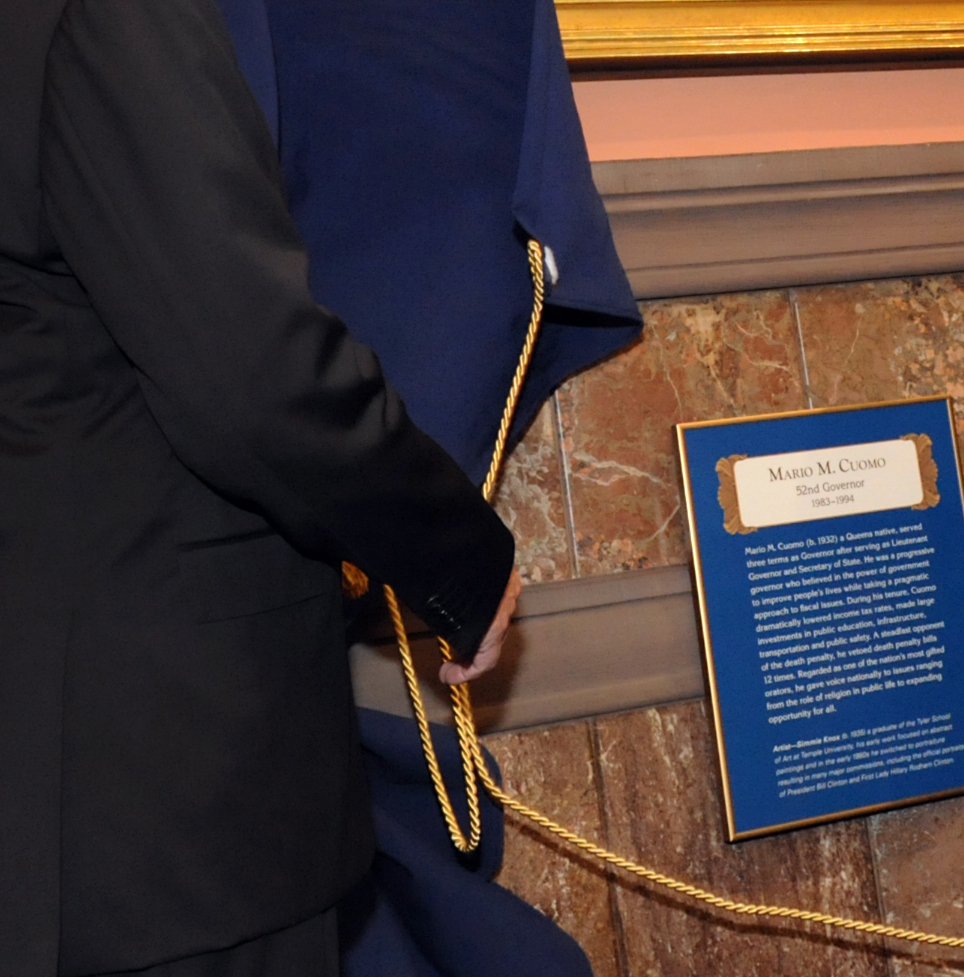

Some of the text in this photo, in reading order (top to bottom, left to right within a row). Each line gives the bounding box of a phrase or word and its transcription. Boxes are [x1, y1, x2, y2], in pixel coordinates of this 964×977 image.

[817, 461, 836, 476] M.
[796, 480, 865, 495] 52nd Governor
[745, 546, 767, 555] Mario
[767, 544, 777, 552] M.
[777, 541, 805, 550] Cuomo
[806, 538, 816, 548] (b.
[817, 535, 838, 545] 1932)
[845, 531, 873, 541] Queens
[899, 523, 923, 533] served
[746, 559, 766, 568] three
[767, 556, 789, 565] terms
[800, 550, 834, 560] Governor
[836, 546, 853, 555] after
[854, 543, 881, 552] serving
[891, 535, 928, 547] Lieutenant
[748, 570, 782, 581] Governor
[783, 566, 798, 576] and
[798, 563, 832, 573] Secretary
[833, 559, 841, 568] of
[842, 558, 862, 567] State.
[864, 555, 874, 563] He
[896, 547, 935, 560] progressive
[750, 583, 783, 596] governor
[785, 580, 801, 588] who
[801, 574, 833, 586] believed
[855, 569, 877, 579] power
[879, 566, 887, 574] of
[888, 560, 930, 574] government
[751, 599, 761, 607] to
[761, 595, 792, 605] improve
[825, 587, 842, 595] lives
[843, 583, 863, 592] while
[863, 580, 887, 589] taking
[894, 573, 929, 586] pragmatic
[754, 607, 789, 620] approach
[799, 602, 820, 612] fiscal
[846, 595, 872, 605] During
[872, 593, 884, 601] his
[910, 585, 937, 594] Cuomo
[755, 618, 802, 633] dramatically
[802, 613, 832, 625] lowered
[833, 610, 860, 620] income
[895, 600, 916, 609] made
[917, 598, 935, 606] large
[757, 632, 803, 645] investments
[804, 630, 812, 638] in
[813, 626, 835, 638] public
[759, 644, 810, 658] transportation
[811, 640, 825, 650] and
[825, 637, 848, 649] public
[873, 631, 880, 639] A
[880, 626, 912, 638] steadfast
[912, 621, 945, 633] opponent
[761, 662, 769, 671] of
[770, 661, 783, 670] the
[784, 657, 806, 668] death
[848, 645, 873, 656] vetoed
[873, 642, 894, 652] death
[895, 638, 921, 650] penalty
[922, 634, 938, 643] bills
[764, 675, 773, 684] 12
[773, 673, 796, 682] times.
[797, 665, 833, 679] Regarded
[842, 662, 857, 670] one
[857, 659, 865, 668] of
[866, 658, 878, 666] the
[907, 650, 925, 659] most
[925, 646, 945, 658] gifted
[795, 684, 805, 692] he
[806, 681, 825, 692] gave
[825, 677, 846, 686] voice
[846, 670, 882, 683] nationally
[892, 665, 915, 675] issues
[916, 660, 943, 670] ranging
[766, 701, 785, 710] from
[785, 699, 798, 707] the
[799, 696, 814, 704] role
[815, 692, 823, 702] of
[824, 689, 852, 700] religion
[861, 683, 883, 695] public
[884, 680, 896, 689] life
[906, 673, 943, 685] expanding
[768, 704, 837, 724] opportunity for all.
